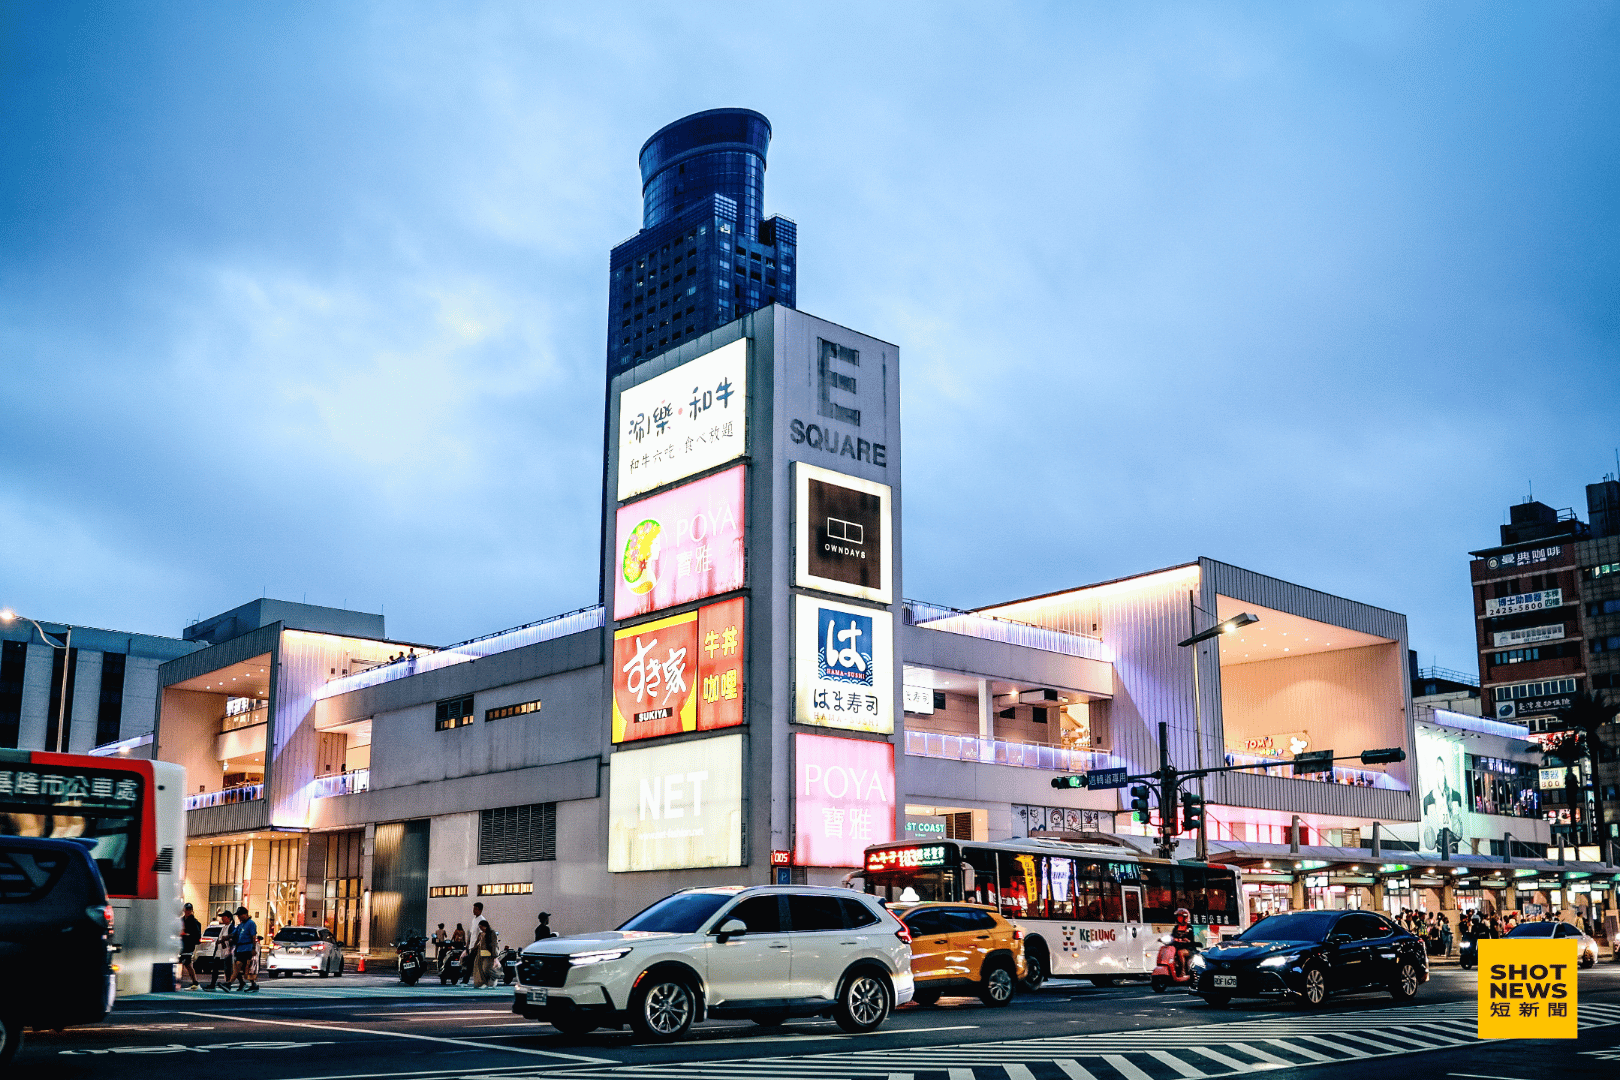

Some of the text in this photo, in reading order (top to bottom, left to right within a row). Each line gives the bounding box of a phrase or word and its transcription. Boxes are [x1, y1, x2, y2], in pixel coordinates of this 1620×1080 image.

[817, 336, 860, 427] E
[790, 418, 886, 468] SQUARE
[676, 503, 737, 548] POYA
[824, 543, 866, 559] OWNDAYS
[1489, 602, 1543, 616] 2425-5800
[704, 625, 738, 659] 牛丼
[826, 619, 867, 672] は
[622, 636, 687, 706] すき家
[703, 669, 738, 703] 咖哩
[826, 668, 866, 680] HAMA-SUSHI
[638, 708, 668, 722] SUKIYA
[813, 688, 879, 716] はま寿司
[1245, 736, 1274, 750] TOM'S
[640, 770, 709, 821] NET
[804, 763, 888, 802] POYA
[821, 806, 872, 841] 寶雅
[905, 821, 945, 833] ST COAST
[1079, 928, 1116, 943] KEELUNG
